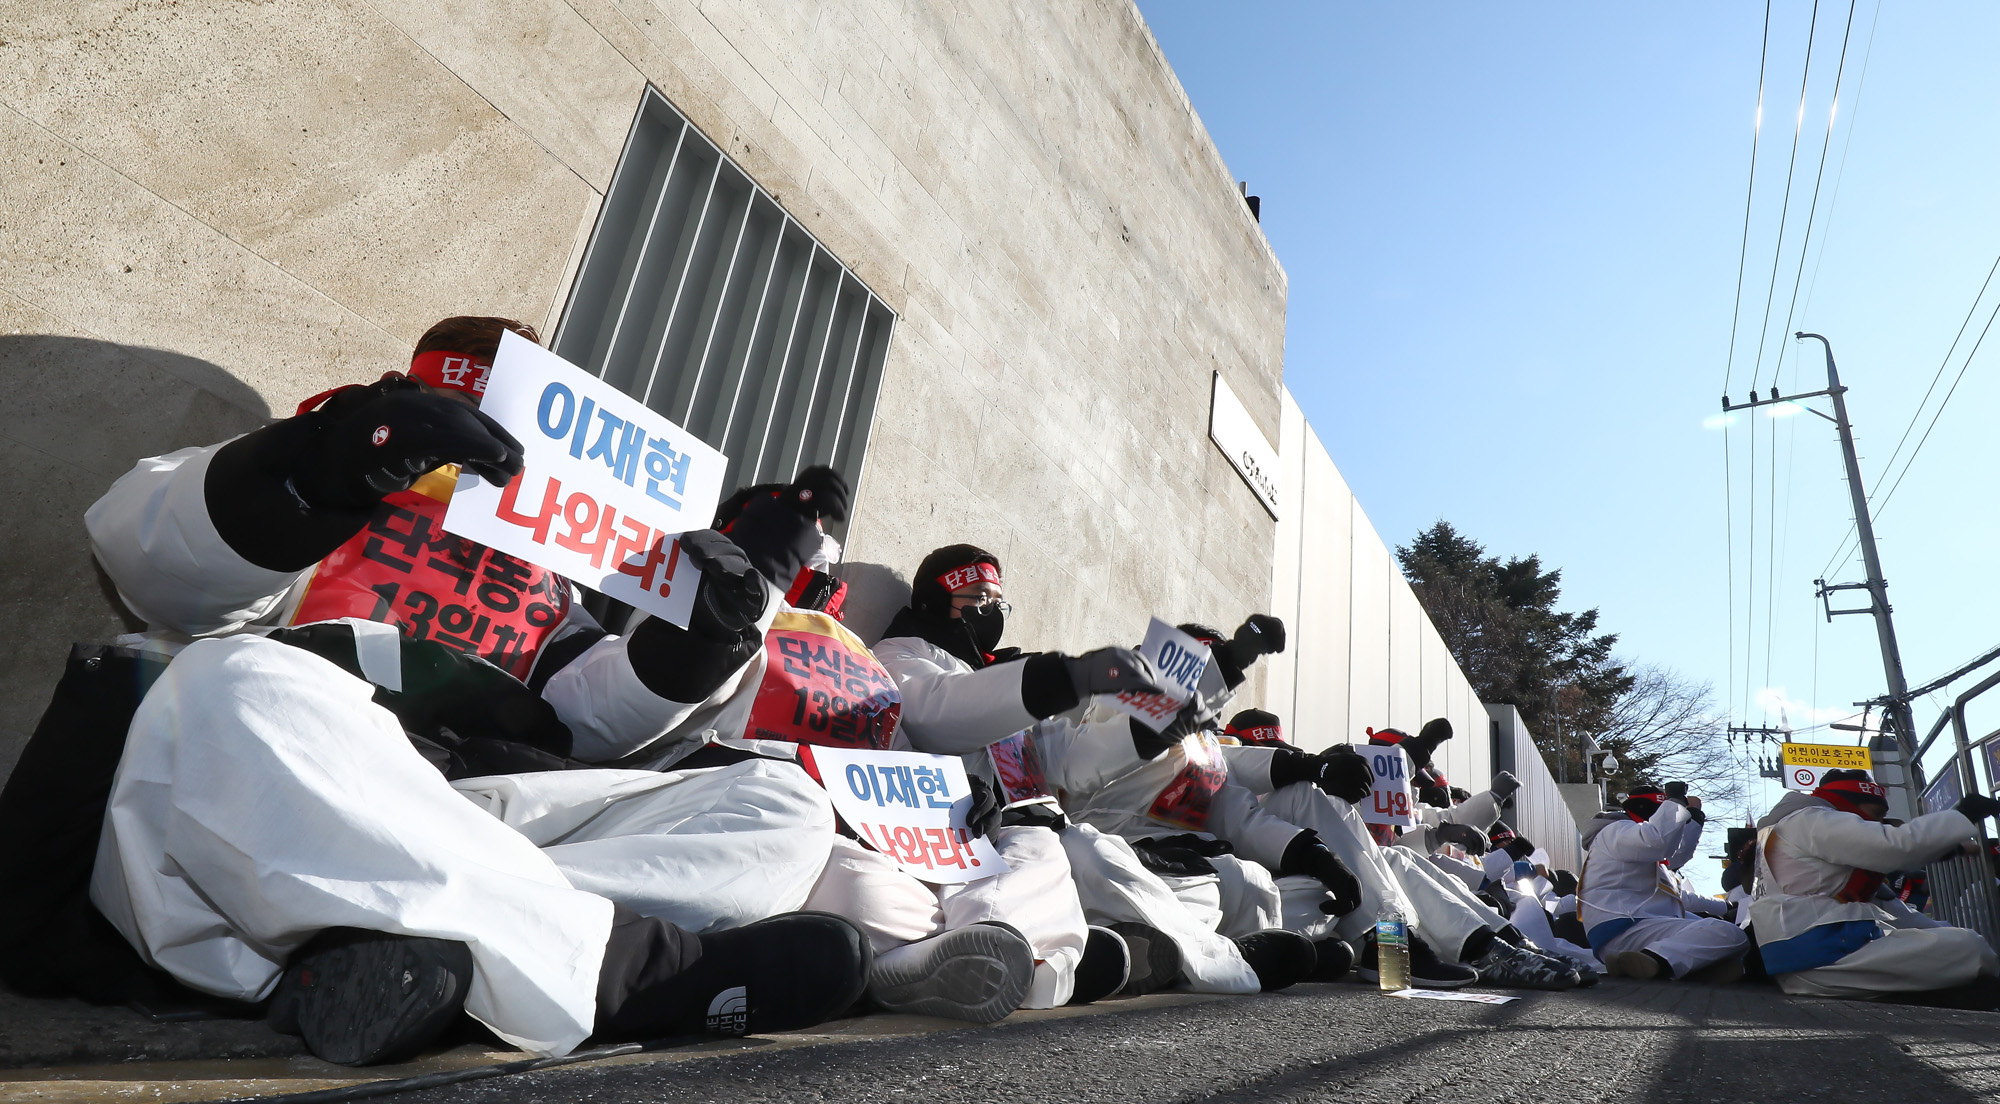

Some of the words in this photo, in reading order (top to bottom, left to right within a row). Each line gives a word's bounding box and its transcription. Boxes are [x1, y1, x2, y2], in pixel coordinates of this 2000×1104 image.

[537, 381, 692, 512] 이재현
[495, 466, 681, 598] 나와라!
[944, 565, 979, 590] 단결
[1252, 727, 1275, 741] 단결
[1787, 746, 1866, 759] 어린이보호구역
[1791, 756, 1831, 765] SCHOOL
[1837, 759, 1864, 767] ZONE
[845, 763, 953, 809] 이재현
[1798, 773, 1811, 781] 30
[860, 822, 981, 870] 나와라!
